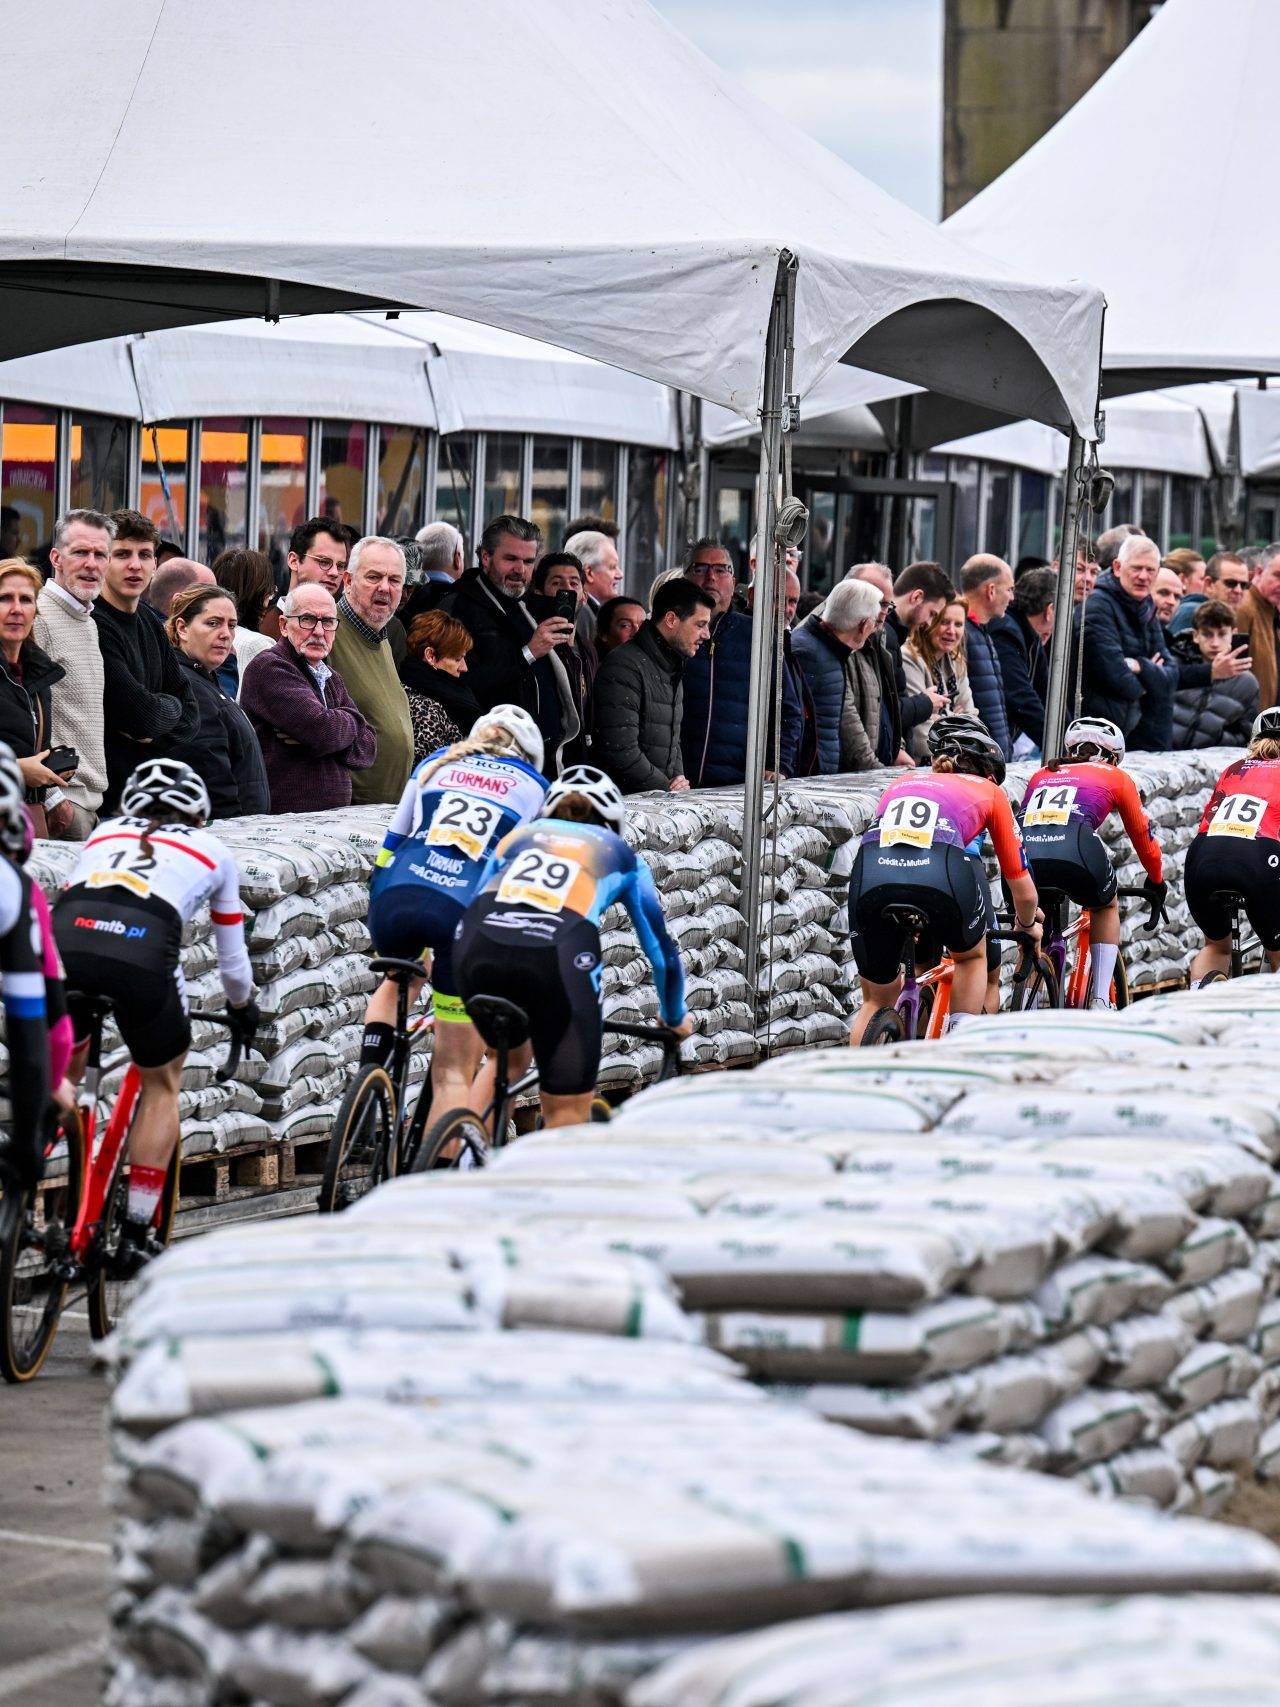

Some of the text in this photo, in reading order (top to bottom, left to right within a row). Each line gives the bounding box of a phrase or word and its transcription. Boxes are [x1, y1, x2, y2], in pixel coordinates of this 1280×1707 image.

[461, 758, 515, 774] CROG
[450, 770, 510, 795] TORMANS
[1034, 788, 1069, 809] 14
[1223, 797, 1261, 823] 15
[439, 797, 493, 836] 23
[890, 800, 931, 828] 19
[1047, 834, 1066, 843] Mutuel
[108, 850, 157, 880] 12
[426, 850, 465, 874] TORMANS
[512, 854, 570, 889] 29
[878, 857, 930, 867] Crédit Mutuel
[415, 866, 457, 887] ACROG
[74, 915, 148, 938] namtb.pl
